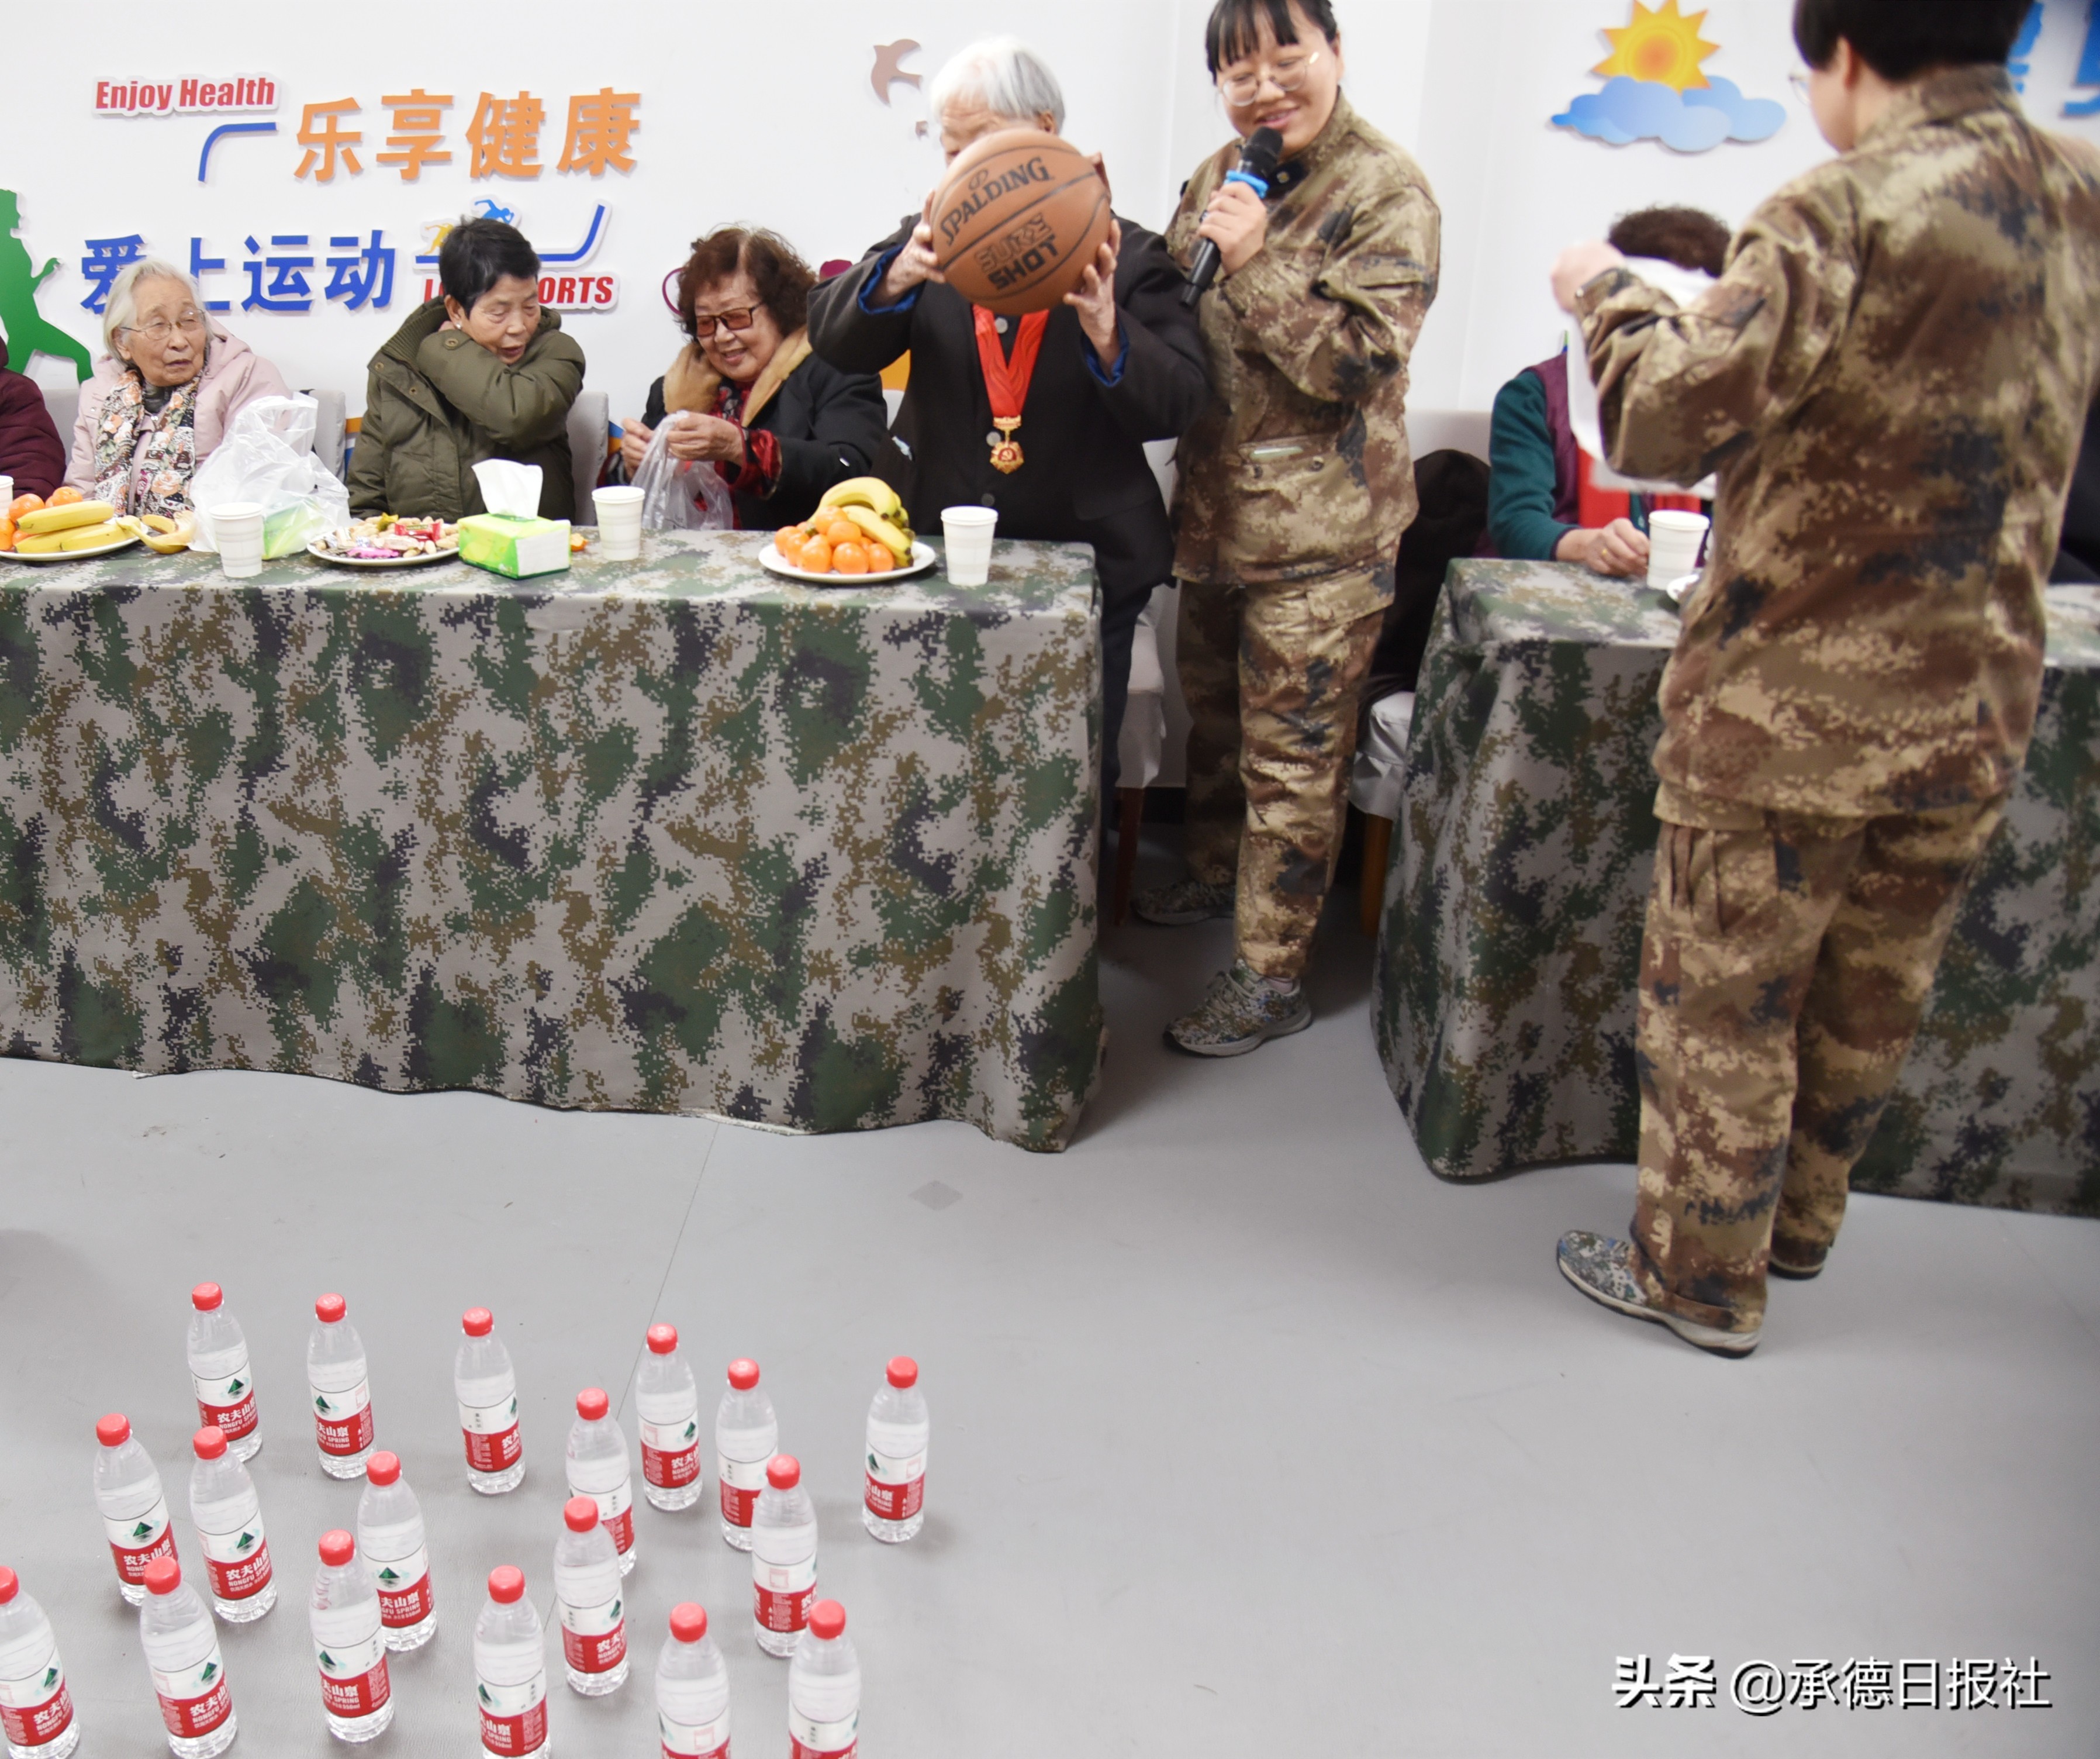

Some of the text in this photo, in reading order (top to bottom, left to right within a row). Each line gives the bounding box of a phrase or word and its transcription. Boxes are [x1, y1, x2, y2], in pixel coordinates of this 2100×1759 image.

[96, 77, 275, 111] Enjoy Health
[293, 87, 641, 181] 乐享健康
[940, 156, 1052, 247] SPALDING
[80, 229, 396, 315] 爱上运动
[987, 234, 1059, 291] SHOT
[538, 276, 614, 304] ORTS
[227, 1574, 255, 1587] NONGFU
[381, 1591, 420, 1609] 夫山泉
[396, 1602, 420, 1615] SPRING
[190, 1682, 227, 1717] 农夫山
[322, 1678, 359, 1697] 夫山泉
[333, 1696, 359, 1704] SPRING
[33, 1689, 68, 1724] 农夫山
[36, 1710, 63, 1731] NONGFU
[192, 1705, 219, 1723] NONGFU
